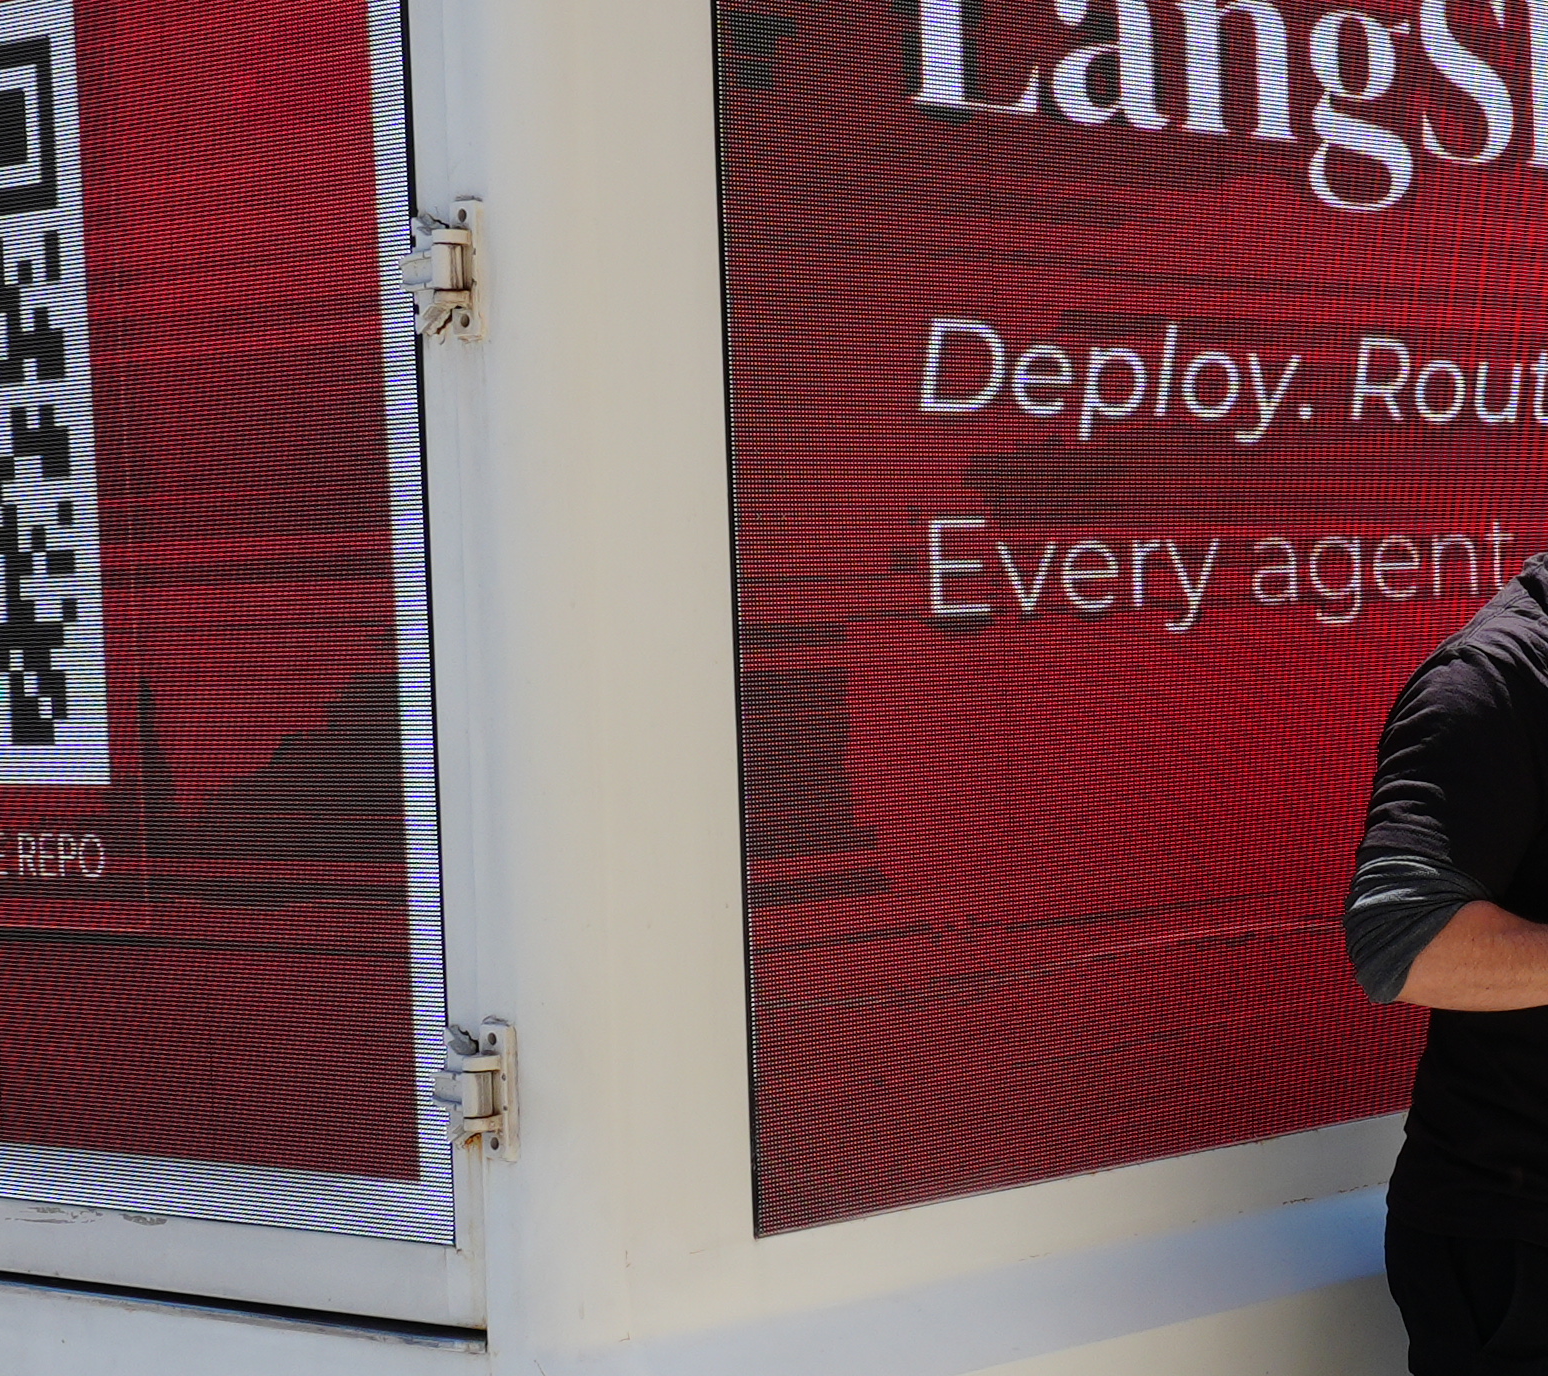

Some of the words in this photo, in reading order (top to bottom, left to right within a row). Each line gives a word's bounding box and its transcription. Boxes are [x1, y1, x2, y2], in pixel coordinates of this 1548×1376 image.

[919, 317, 1314, 443] Deploy.
[927, 517, 1220, 633] Every
[17, 832, 107, 878] REPO
